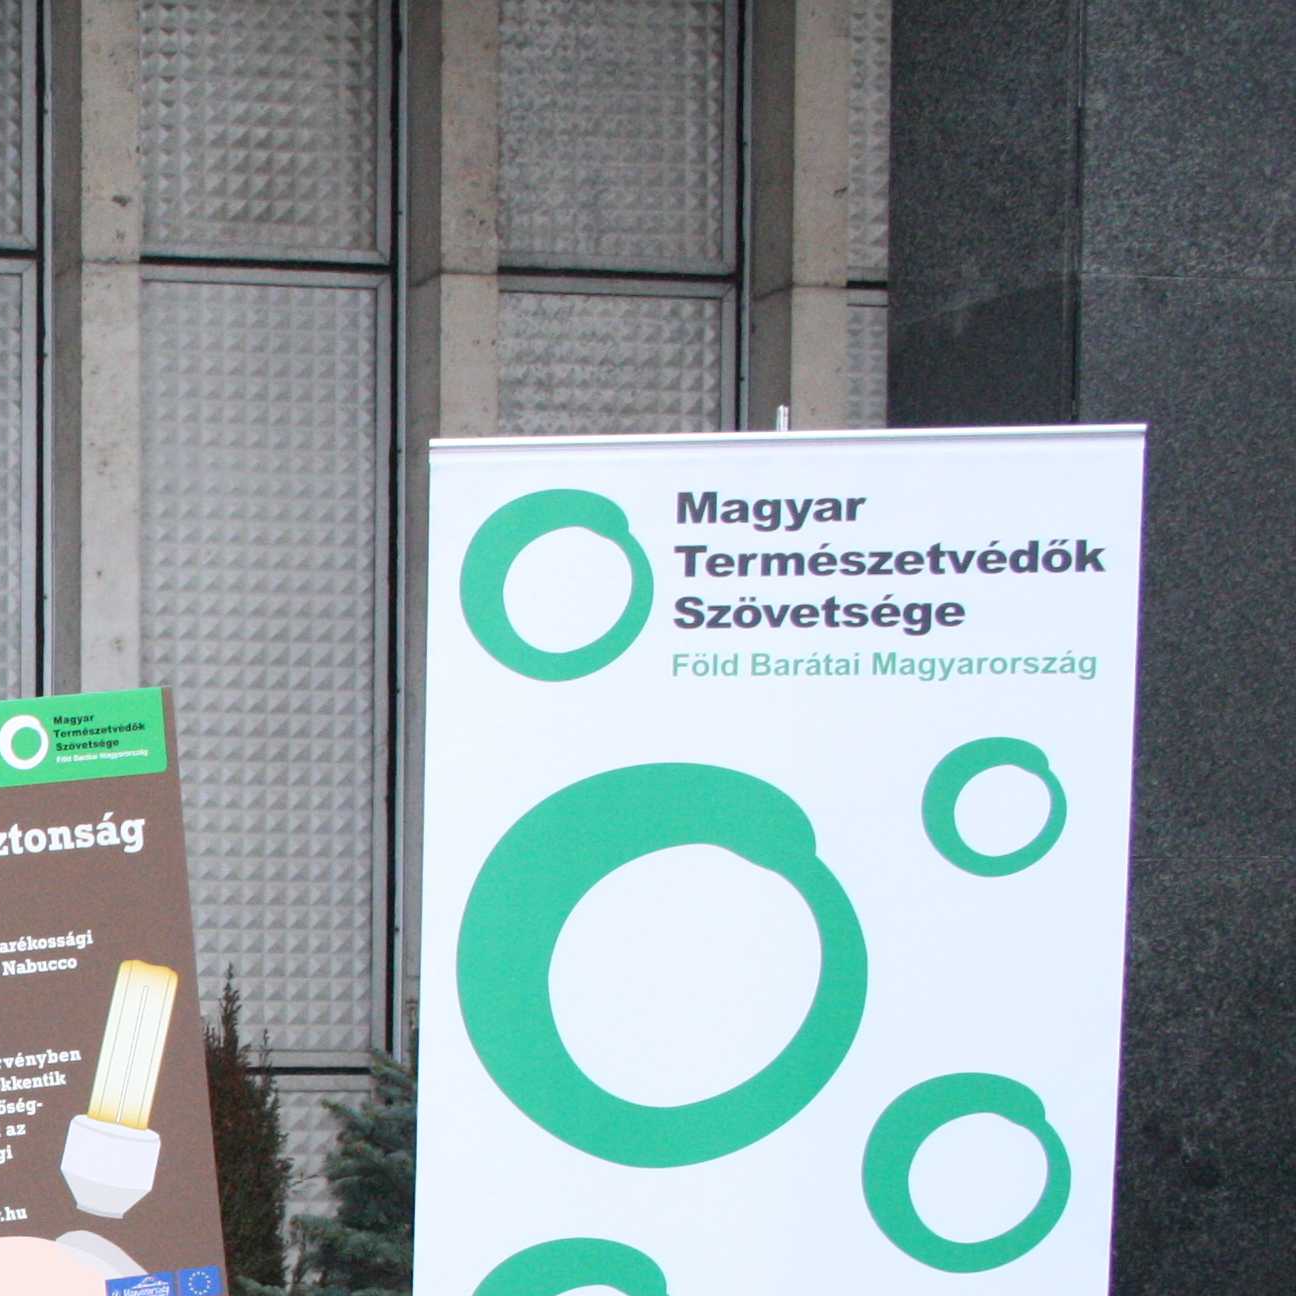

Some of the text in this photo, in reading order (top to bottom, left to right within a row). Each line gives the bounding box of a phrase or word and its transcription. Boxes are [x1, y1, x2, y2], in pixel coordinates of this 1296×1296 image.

[676, 491, 866, 532] Magyar
[673, 539, 1106, 578] Természetvédők
[673, 594, 966, 636] Szövetsége
[672, 650, 1098, 682] Föld Barátai Magyarország
[2, 957, 77, 977] Nabucco
[6, 1123, 26, 1137] az
